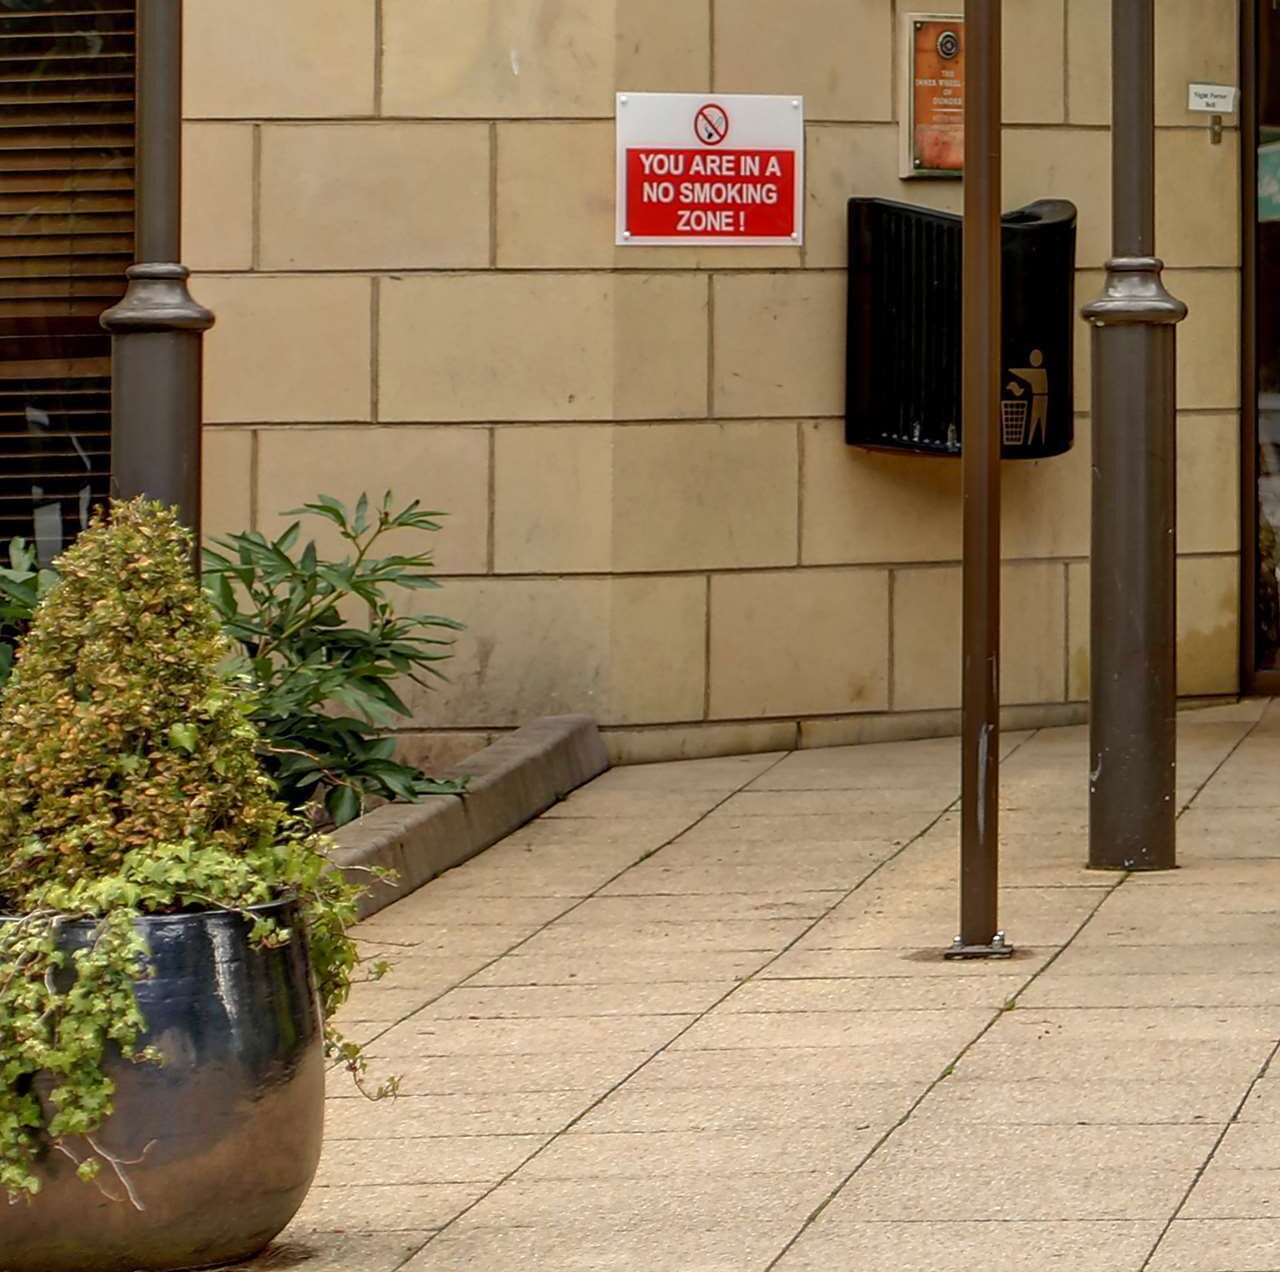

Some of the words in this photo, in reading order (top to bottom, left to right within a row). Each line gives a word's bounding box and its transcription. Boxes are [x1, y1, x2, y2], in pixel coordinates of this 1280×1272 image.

[640, 154, 684, 175] YOU
[689, 155, 735, 175] ARE
[740, 156, 760, 176] IN
[765, 156, 781, 177] A
[643, 182, 675, 203] NO
[679, 182, 777, 204] SMOKING
[676, 210, 734, 231] ZONE
